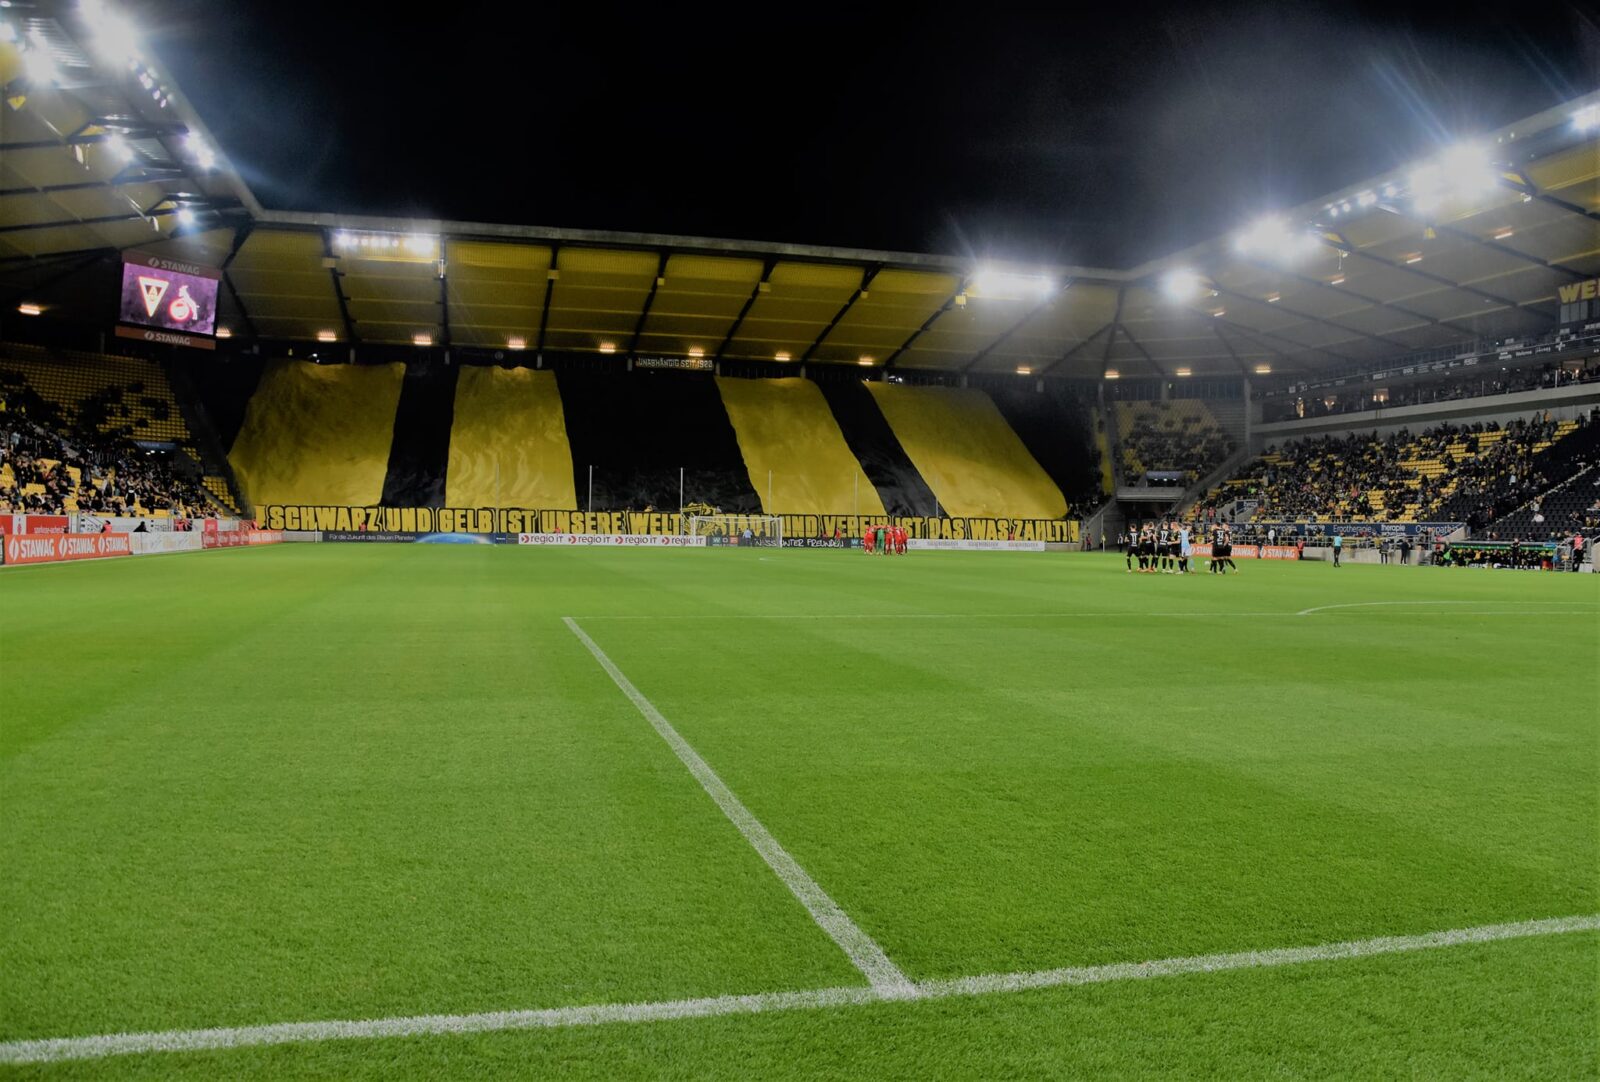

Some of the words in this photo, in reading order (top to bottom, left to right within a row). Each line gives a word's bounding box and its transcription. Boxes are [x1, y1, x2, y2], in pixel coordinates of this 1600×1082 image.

[161, 260, 200, 275] STAWAG
[1558, 278, 1600, 304] WE
[155, 333, 191, 345] STAWAG
[269, 506, 379, 531] SCHWARZ
[386, 507, 431, 532] UND
[440, 508, 493, 533] GELB
[500, 509, 535, 534] IST
[541, 510, 622, 535] UNSERE
[629, 512, 681, 535] WELT
[782, 515, 818, 538] UND
[928, 518, 965, 540] DAS
[969, 518, 1009, 541] WAS
[1013, 519, 1067, 542] ZÄHLT!
[106, 536, 128, 553] STAWAG
[530, 534, 554, 544] regio
[578, 535, 602, 544] regio
[625, 535, 648, 545] regio
[20, 538, 55, 559] STAWAG
[68, 537, 96, 555] STAWAG
[1196, 546, 1213, 556] STAW
[1267, 548, 1295, 557] STAWAG
